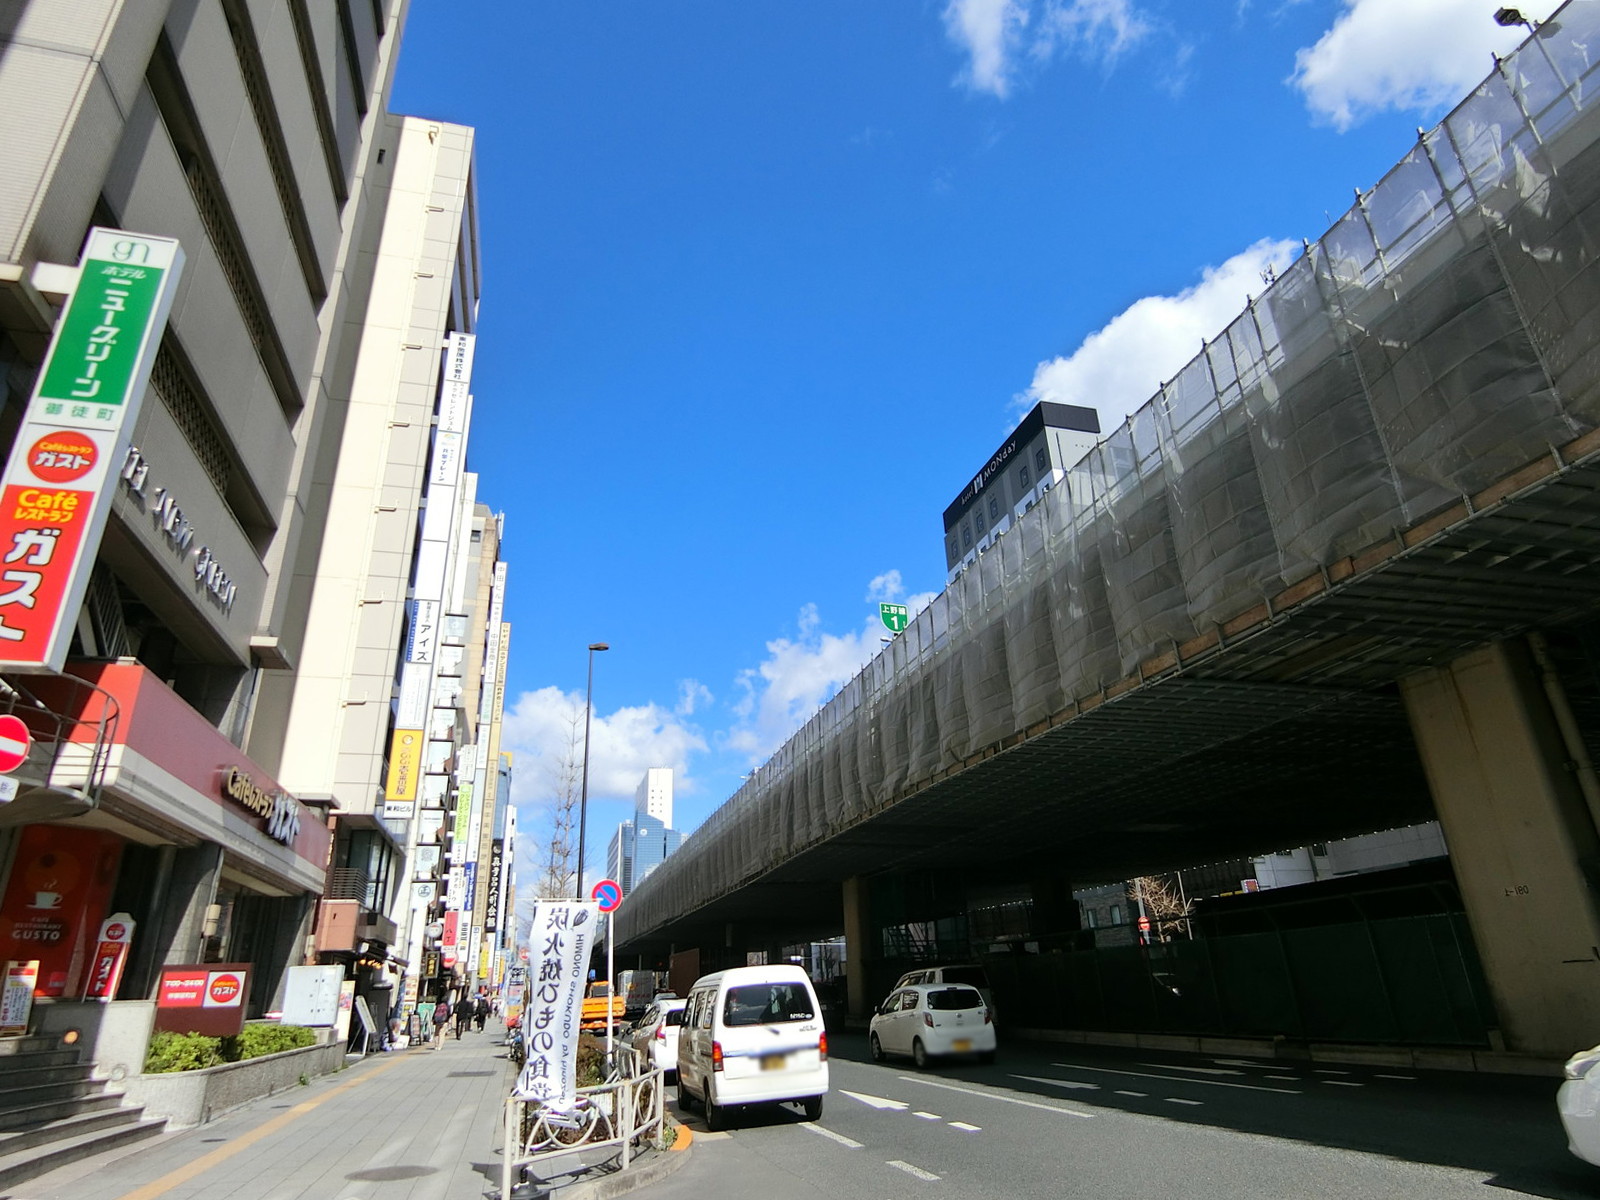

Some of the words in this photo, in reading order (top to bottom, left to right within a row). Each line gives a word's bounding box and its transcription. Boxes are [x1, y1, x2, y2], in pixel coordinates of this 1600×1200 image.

[101, 266, 147, 279] ホテル
[71, 278, 133, 397] ニューグリーン
[45, 403, 115, 421] 御徒町
[34, 451, 91, 470] ガスト
[19, 490, 78, 510] Café
[14, 508, 73, 523] レストラン
[0, 528, 61, 642] ガスト
[890, 616, 898, 630] 1
[417, 625, 431, 661] アイズ
[386, 804, 412, 813] 東和ビル
[12, 929, 60, 940] GUSTO
[95, 955, 115, 992] ガスト
[213, 987, 237, 995] ガスト
